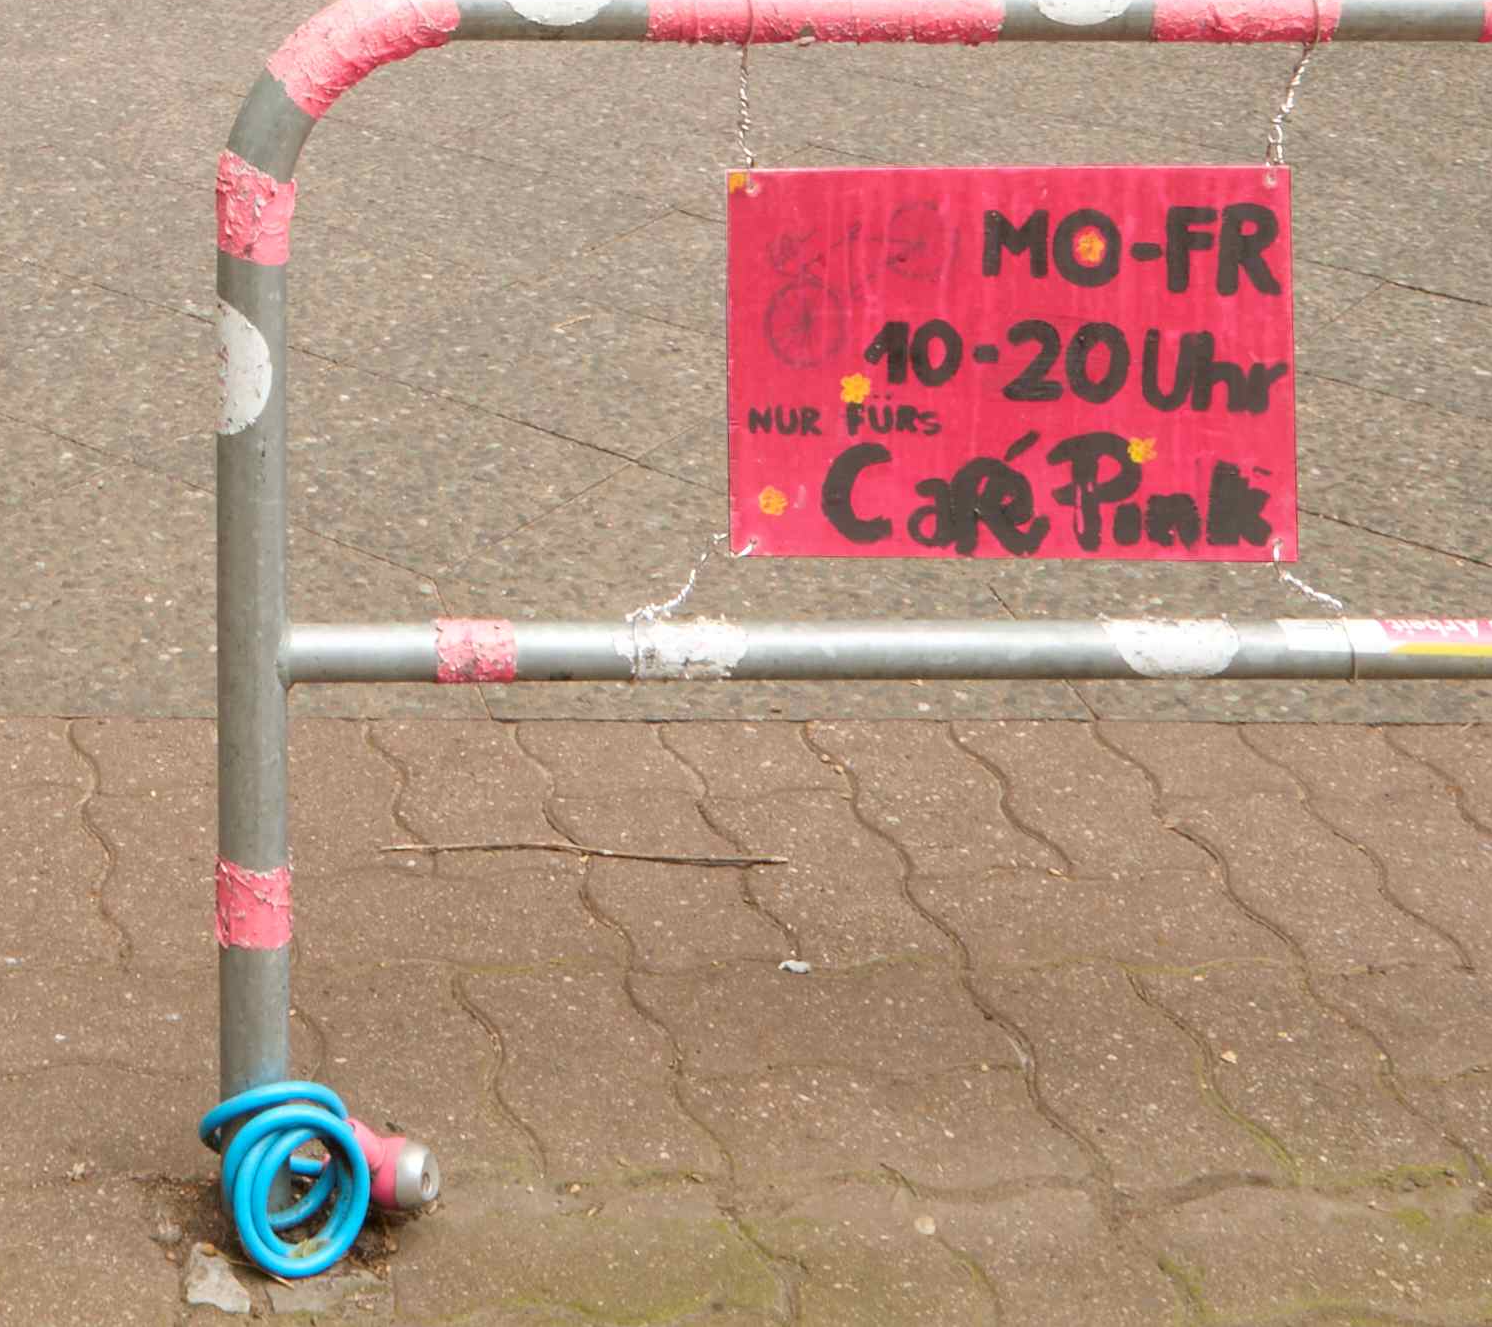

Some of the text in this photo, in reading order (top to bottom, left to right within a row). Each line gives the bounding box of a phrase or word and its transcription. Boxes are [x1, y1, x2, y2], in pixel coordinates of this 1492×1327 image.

[981, 203, 1282, 296] MO-FR
[863, 318, 1289, 414] 10-20 Uhr
[748, 404, 822, 436] NUR
[1046, 430, 1274, 552] Pink
